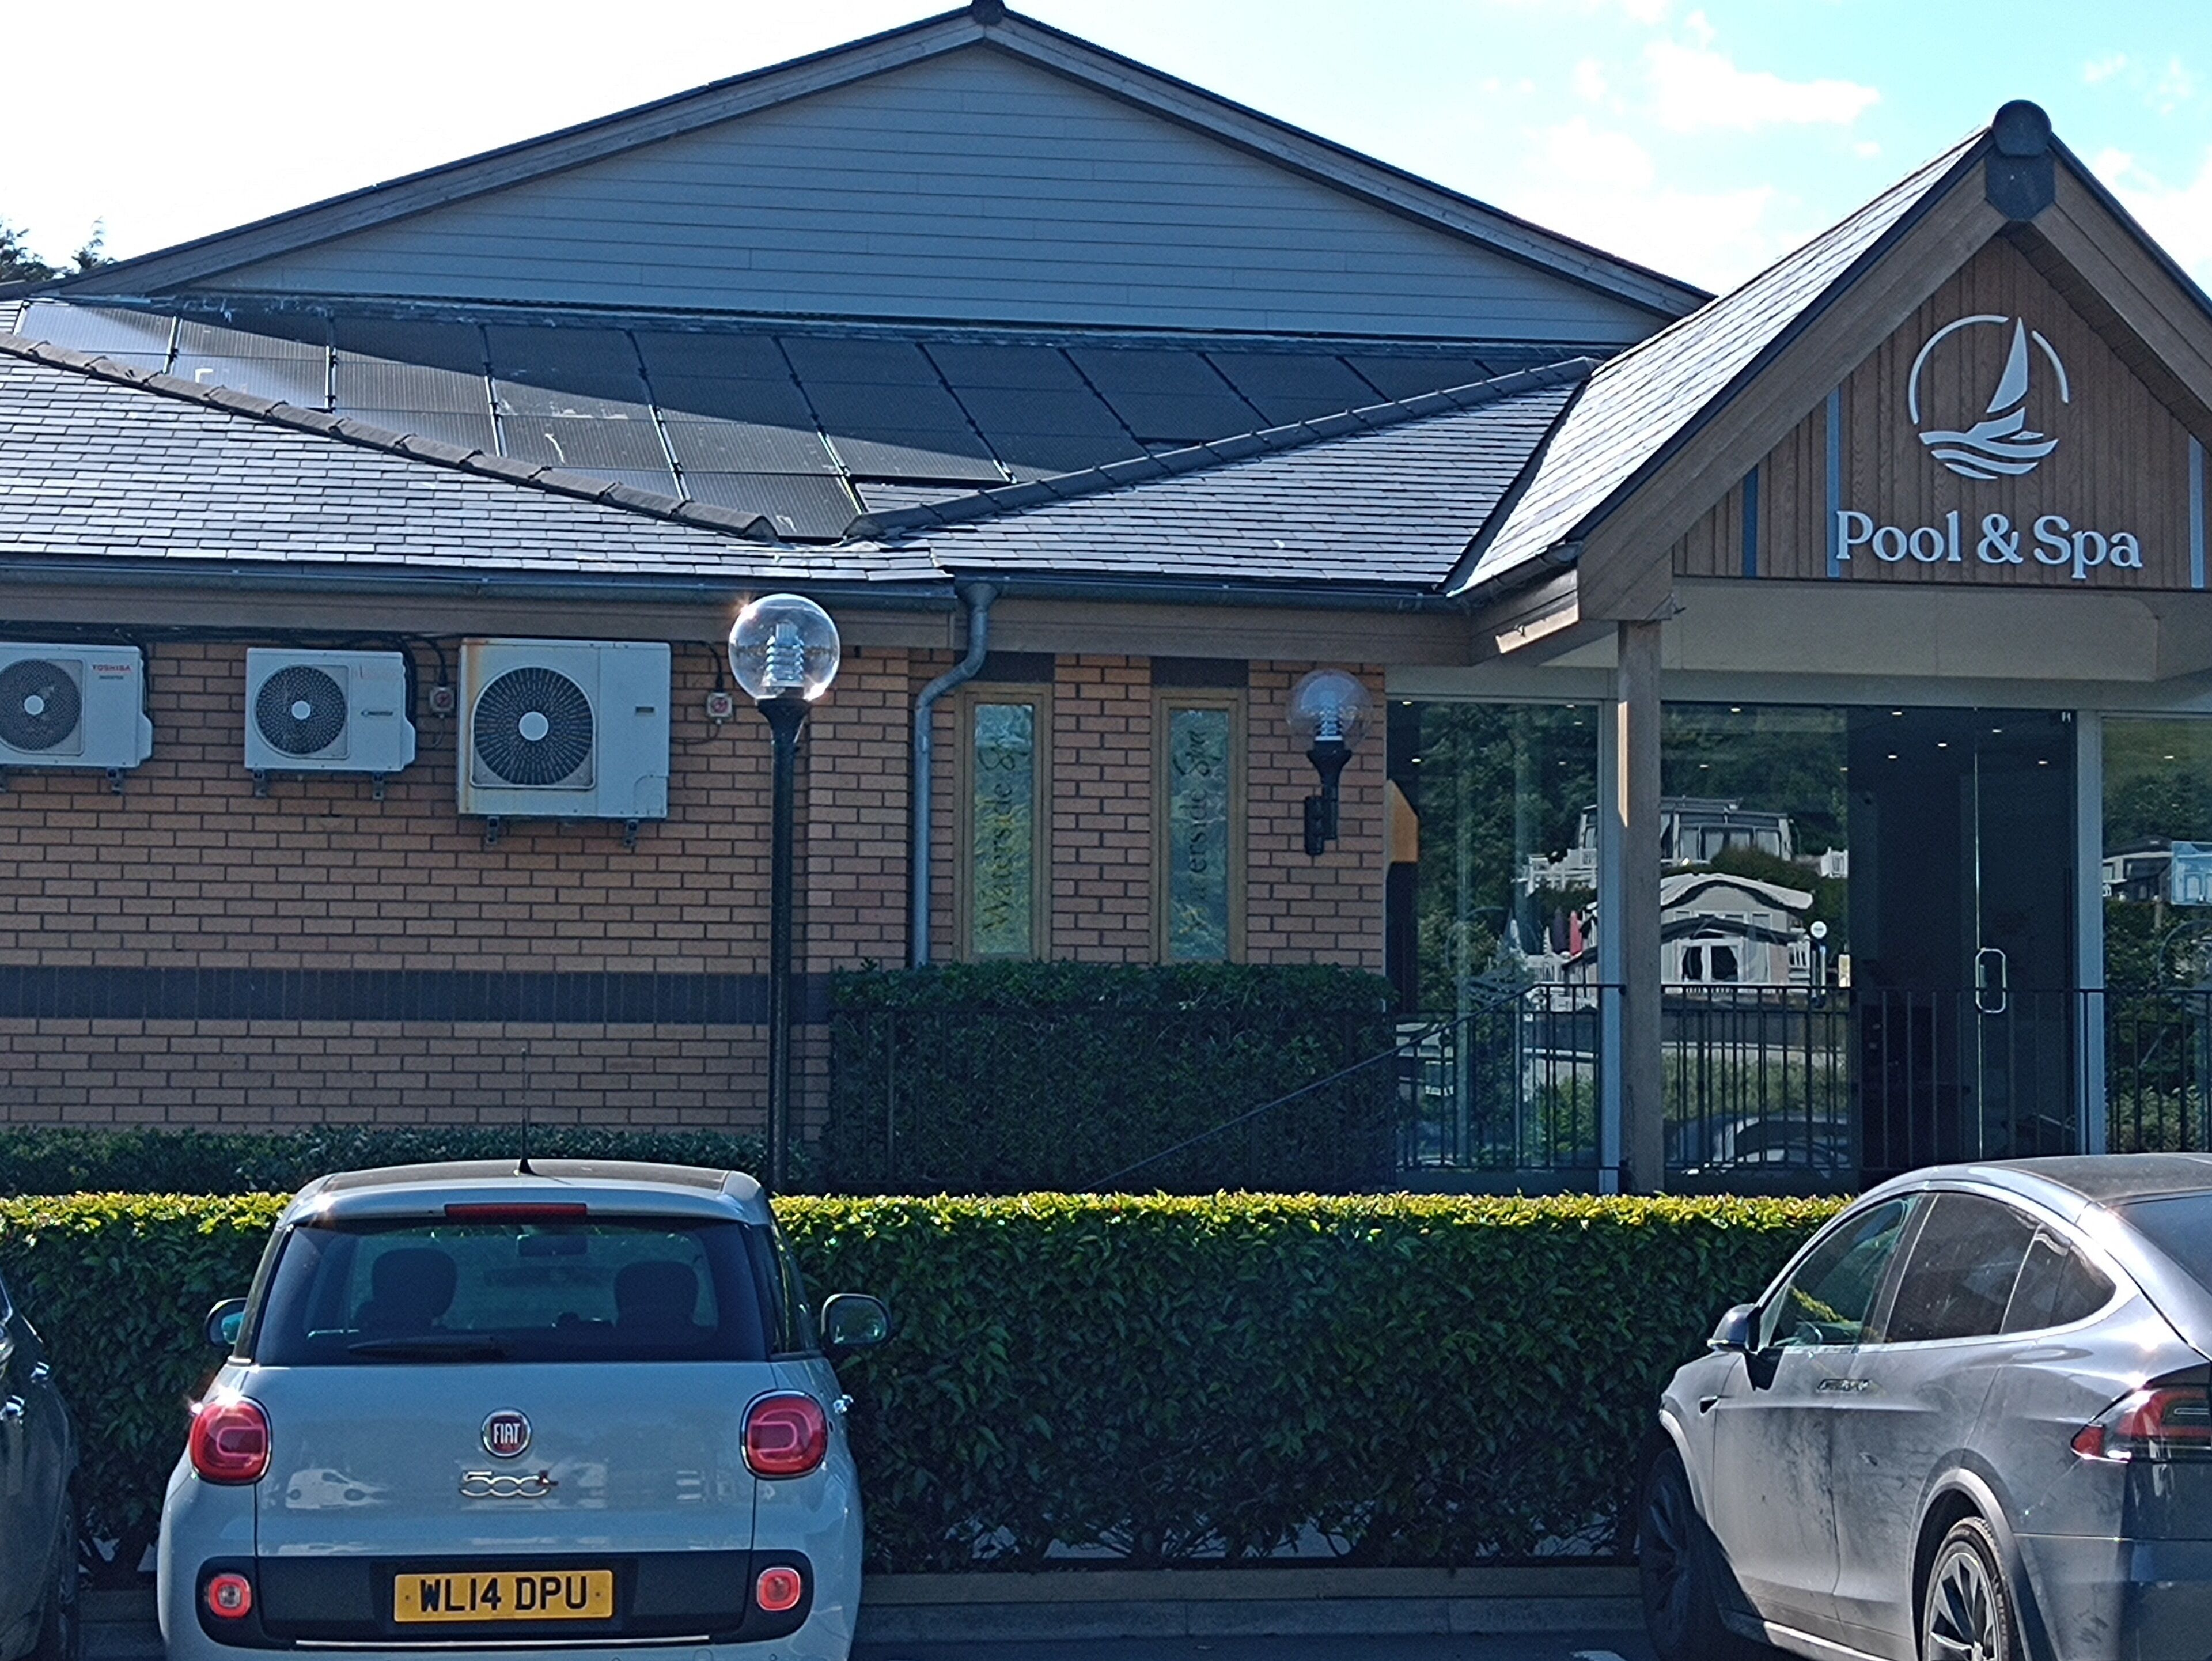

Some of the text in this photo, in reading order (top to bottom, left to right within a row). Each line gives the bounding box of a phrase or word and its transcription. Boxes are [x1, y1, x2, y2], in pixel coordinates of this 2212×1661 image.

[1836, 510, 2143, 579] Pool & Spa
[92, 664, 131, 672] TOSHIBA
[1178, 788, 1208, 934] Waerside
[493, 1422, 521, 1444] FIAT
[419, 1575, 587, 1612] WL14 DPU
